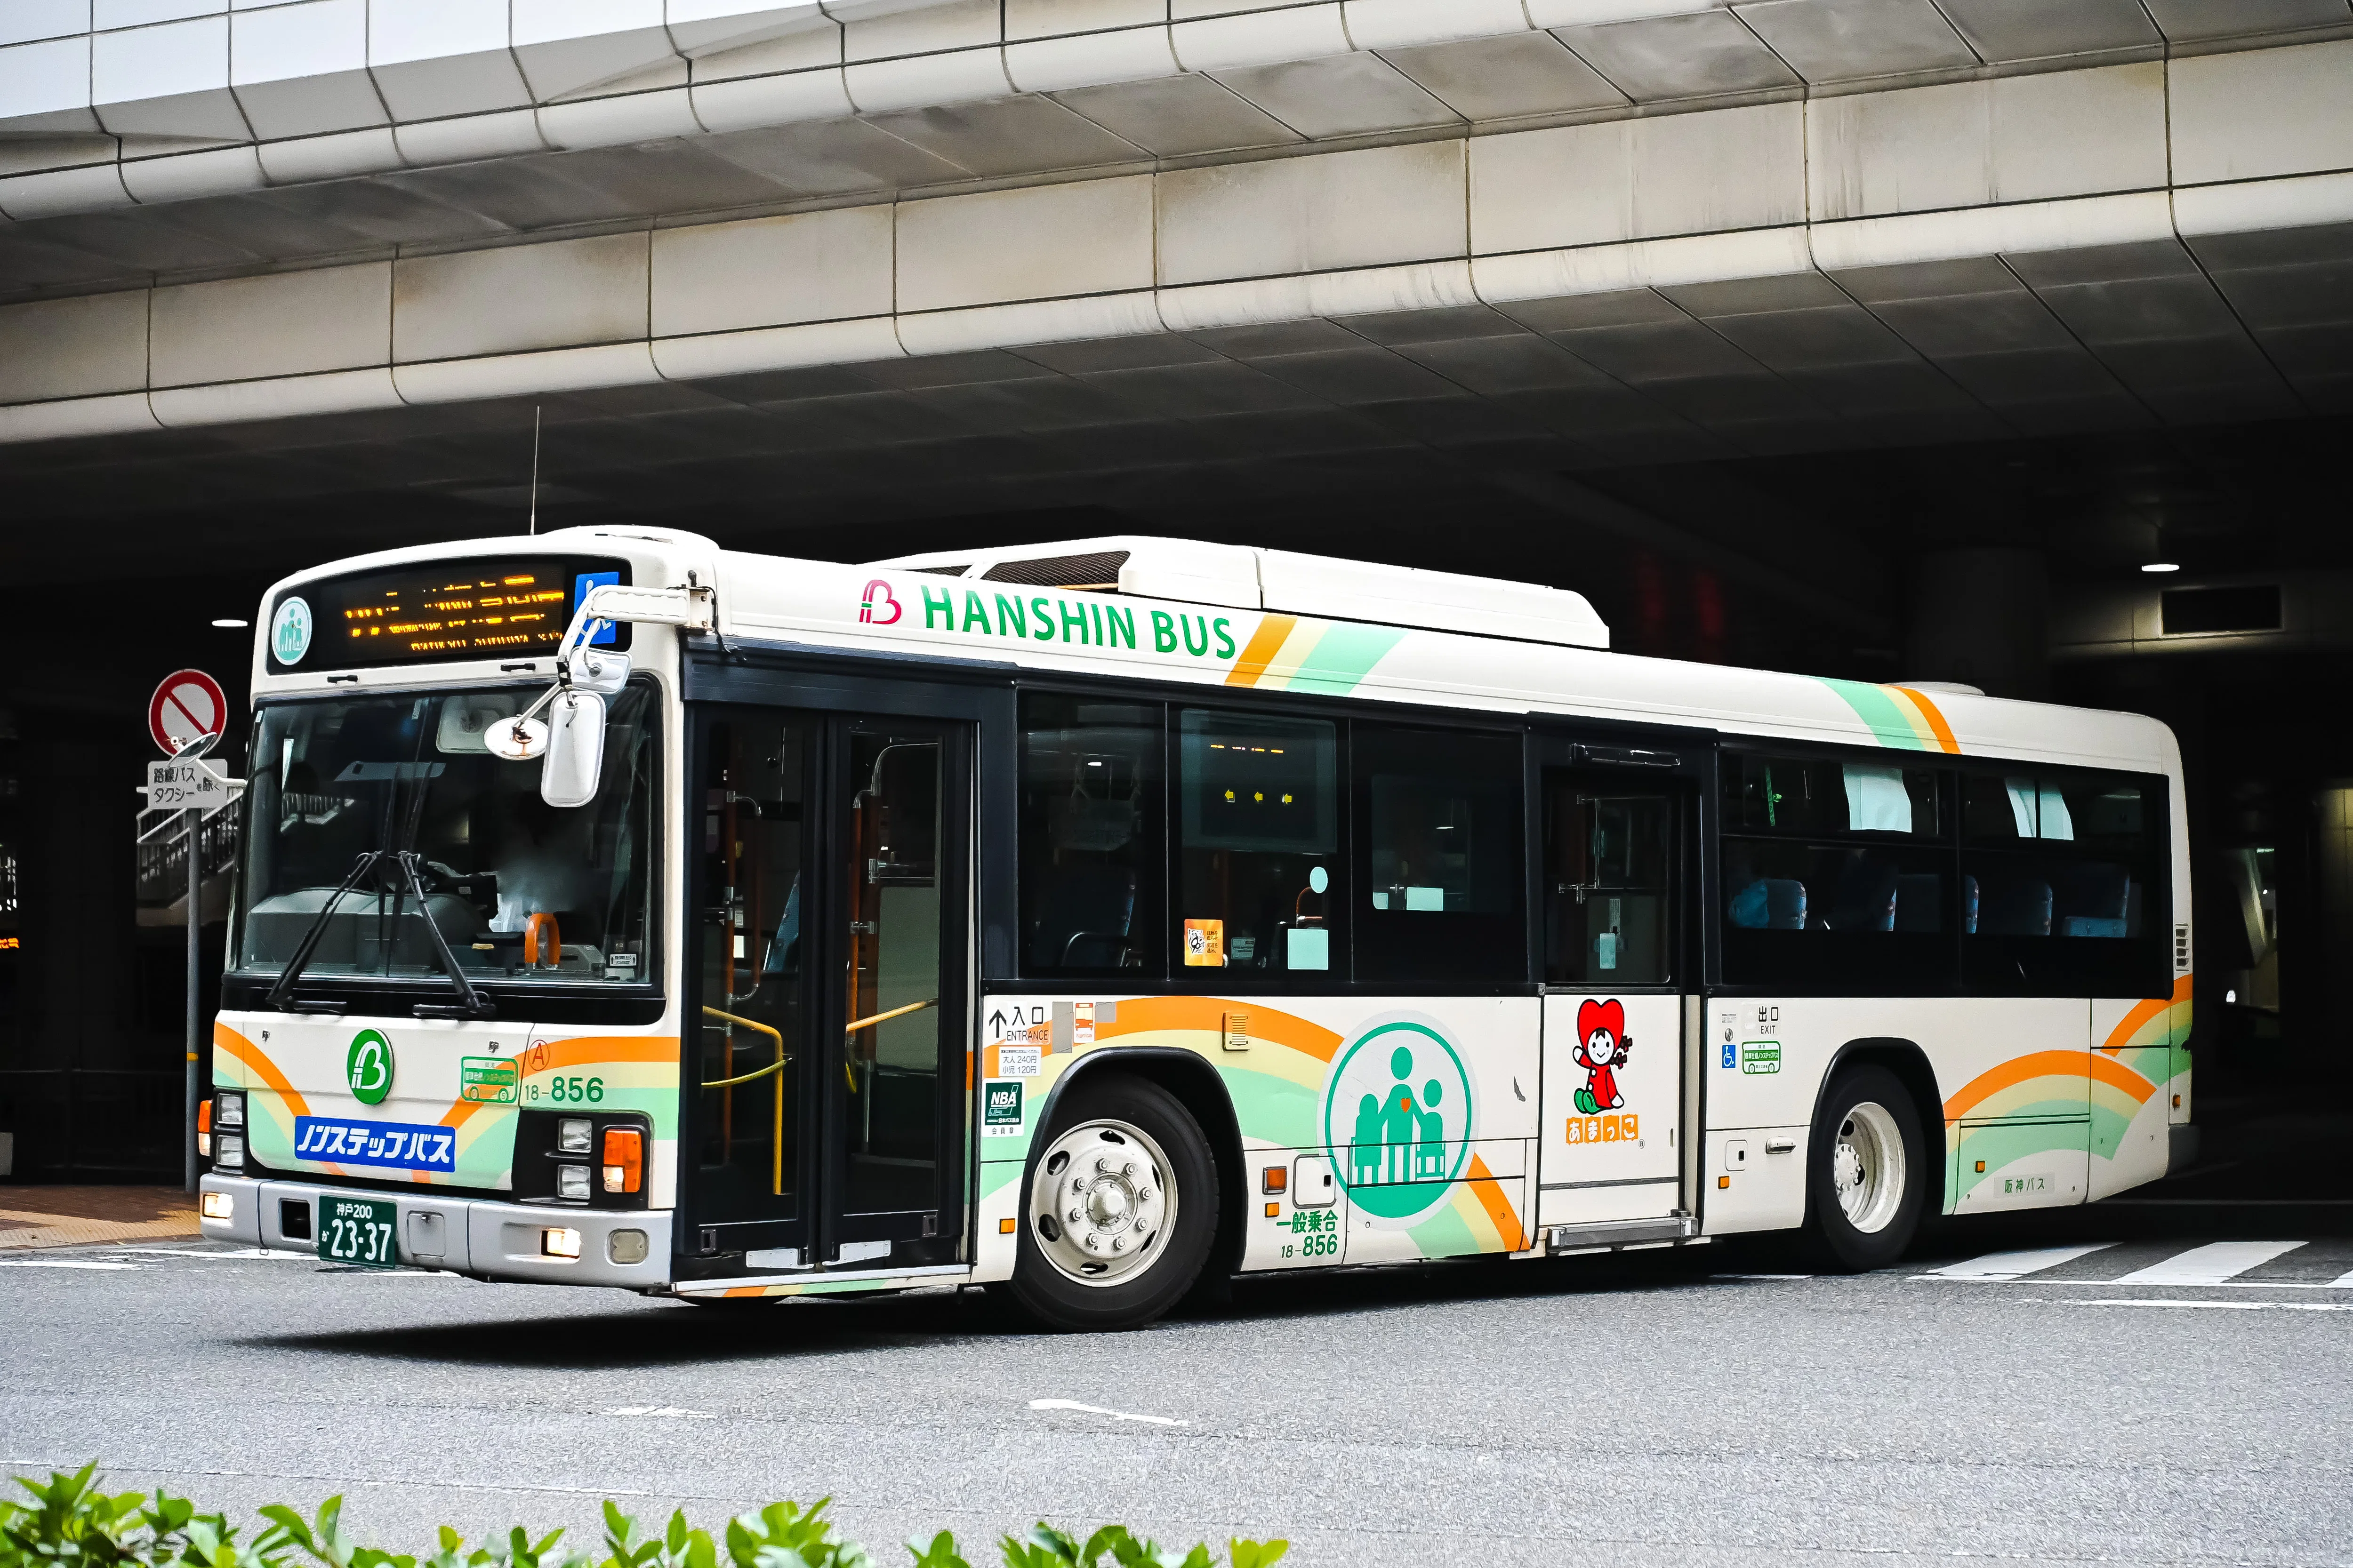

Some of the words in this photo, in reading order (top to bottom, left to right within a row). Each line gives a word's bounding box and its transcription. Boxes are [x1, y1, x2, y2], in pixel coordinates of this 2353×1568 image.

[921, 585, 1136, 649] HANSHIN
[1150, 610, 1236, 659] BUS
[154, 787, 195, 803] タクシー
[1012, 1007, 1044, 1025] 入口
[1758, 1006, 1779, 1022] 出口
[1007, 1030, 1049, 1041] ENTRANCE
[1760, 1025, 1776, 1034] EXIT
[1003, 1056, 1015, 1064] 大人
[1017, 1056, 1037, 1064] 240円
[1017, 1065, 1036, 1073] 120円
[525, 1076, 604, 1102] 18-856
[990, 1092, 1016, 1105] NBA
[1568, 1117, 1636, 1142] あまっこ
[297, 1124, 453, 1163] ノンステップバス
[2004, 1177, 2046, 1193] 阪神バス
[1276, 1209, 1338, 1233] 一般乗合
[1281, 1234, 1338, 1258] 18-856
